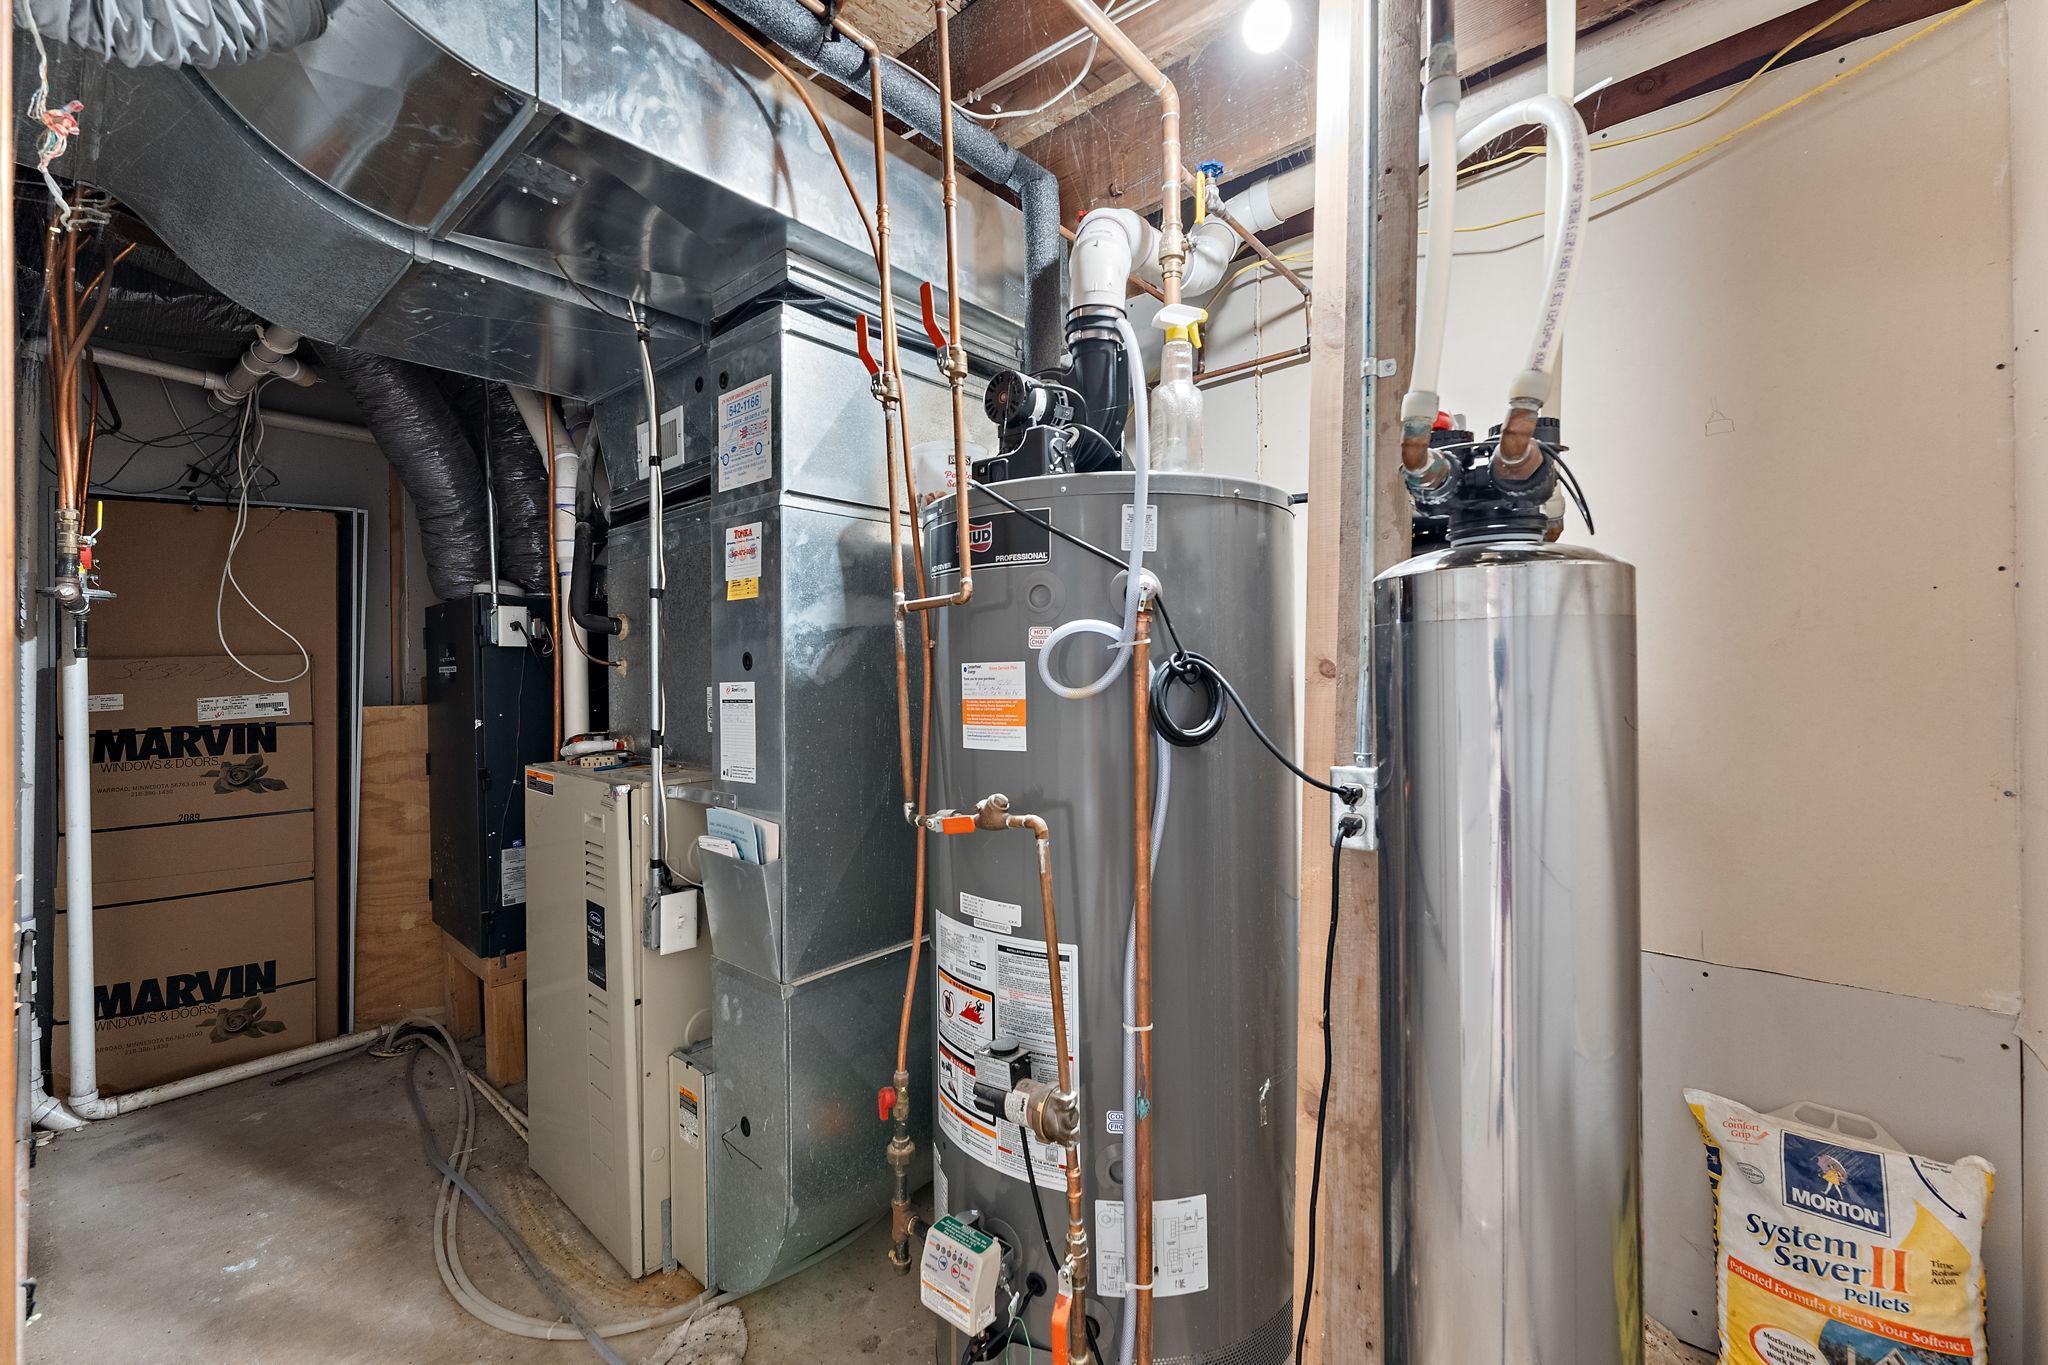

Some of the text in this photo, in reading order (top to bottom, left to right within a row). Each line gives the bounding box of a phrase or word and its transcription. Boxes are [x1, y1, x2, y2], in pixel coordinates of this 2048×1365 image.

[728, 394, 760, 417] 542-1166
[995, 552, 1048, 562] PROFESSIONAL
[92, 722, 277, 764] MARVIN
[100, 758, 162, 773] WINDOWS
[163, 758, 174, 769] &
[178, 812, 200, 824] 2089
[94, 959, 277, 1021] MARVIN
[94, 1010, 157, 1032] WINDOWS
[159, 1011, 168, 1023] &
[1722, 1120, 1760, 1131] Comfort
[1731, 1129, 1751, 1141] Grip
[1791, 1187, 1880, 1226] MORTON
[1746, 1213, 1857, 1260] System
[1774, 1246, 1908, 1293] Saver II
[1930, 1260, 1954, 1270] Time
[1931, 1269, 1961, 1277] Release
[1730, 1260, 1967, 1353] Patented Formula Cleans Your Softener
[1844, 1287, 1911, 1315] Pellets
[1763, 1331, 1816, 1360] Morton Helps
[1767, 1342, 1812, 1365] Your Home
[1765, 1350, 1789, 1365] Work
